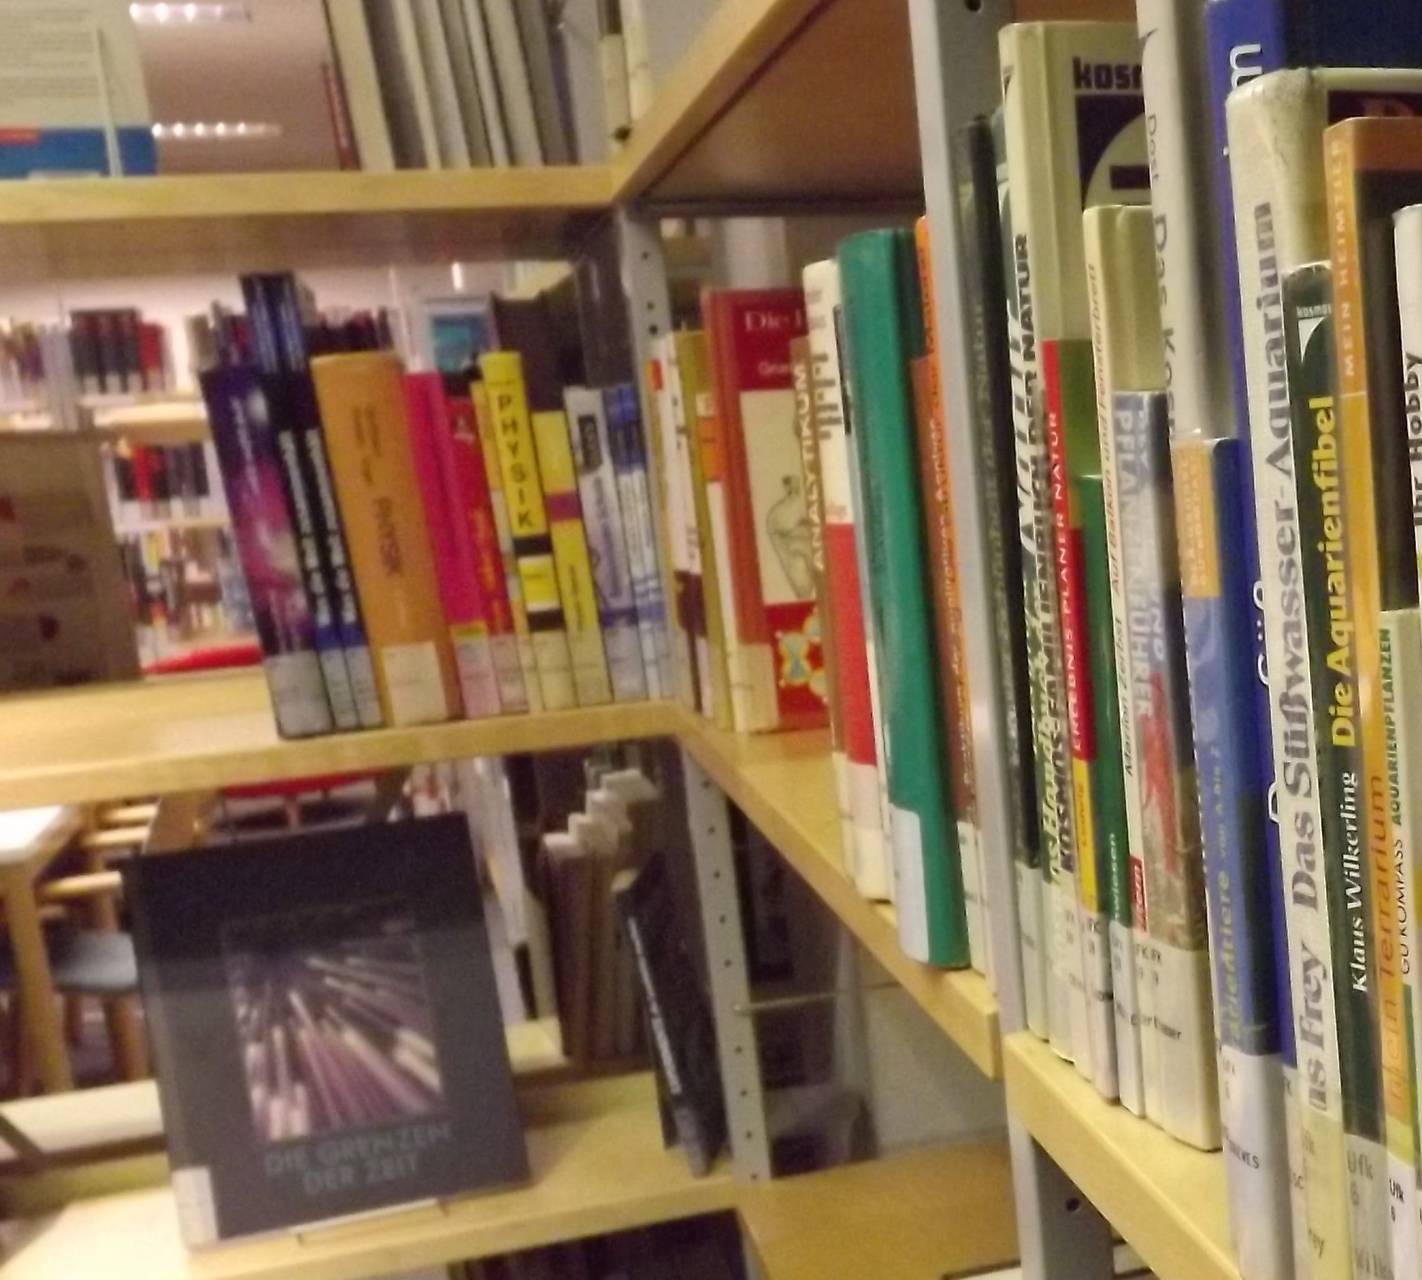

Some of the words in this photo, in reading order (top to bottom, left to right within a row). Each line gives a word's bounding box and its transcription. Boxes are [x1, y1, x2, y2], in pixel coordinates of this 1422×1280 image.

[1073, 57, 1143, 90] kos
[1013, 233, 1036, 362] NATUR
[1340, 302, 1355, 377] MEIN
[497, 393, 533, 528] PHYSIK
[793, 362, 824, 572] ANALYTIKUM
[1048, 409, 1063, 501] NATUR
[1253, 201, 1314, 801] Süßwasser-Aquarium
[1056, 512, 1070, 615] PLANER
[1308, 396, 1353, 677] Aquarienfibel
[1063, 627, 1082, 752] ERLEBNIS
[1119, 696, 1133, 778] Marion
[1328, 682, 1357, 747] Die
[1379, 627, 1402, 827] AQUARIENPFLANZEN
[1289, 810, 1319, 913] Das
[1339, 771, 1364, 911] Wilkerling
[1370, 775, 1398, 980] Terrarium
[1393, 838, 1408, 937] KOMPASS
[1299, 939, 1328, 1053] Frey
[1348, 915, 1368, 993] Klaus
[1399, 943, 1410, 975] GU
